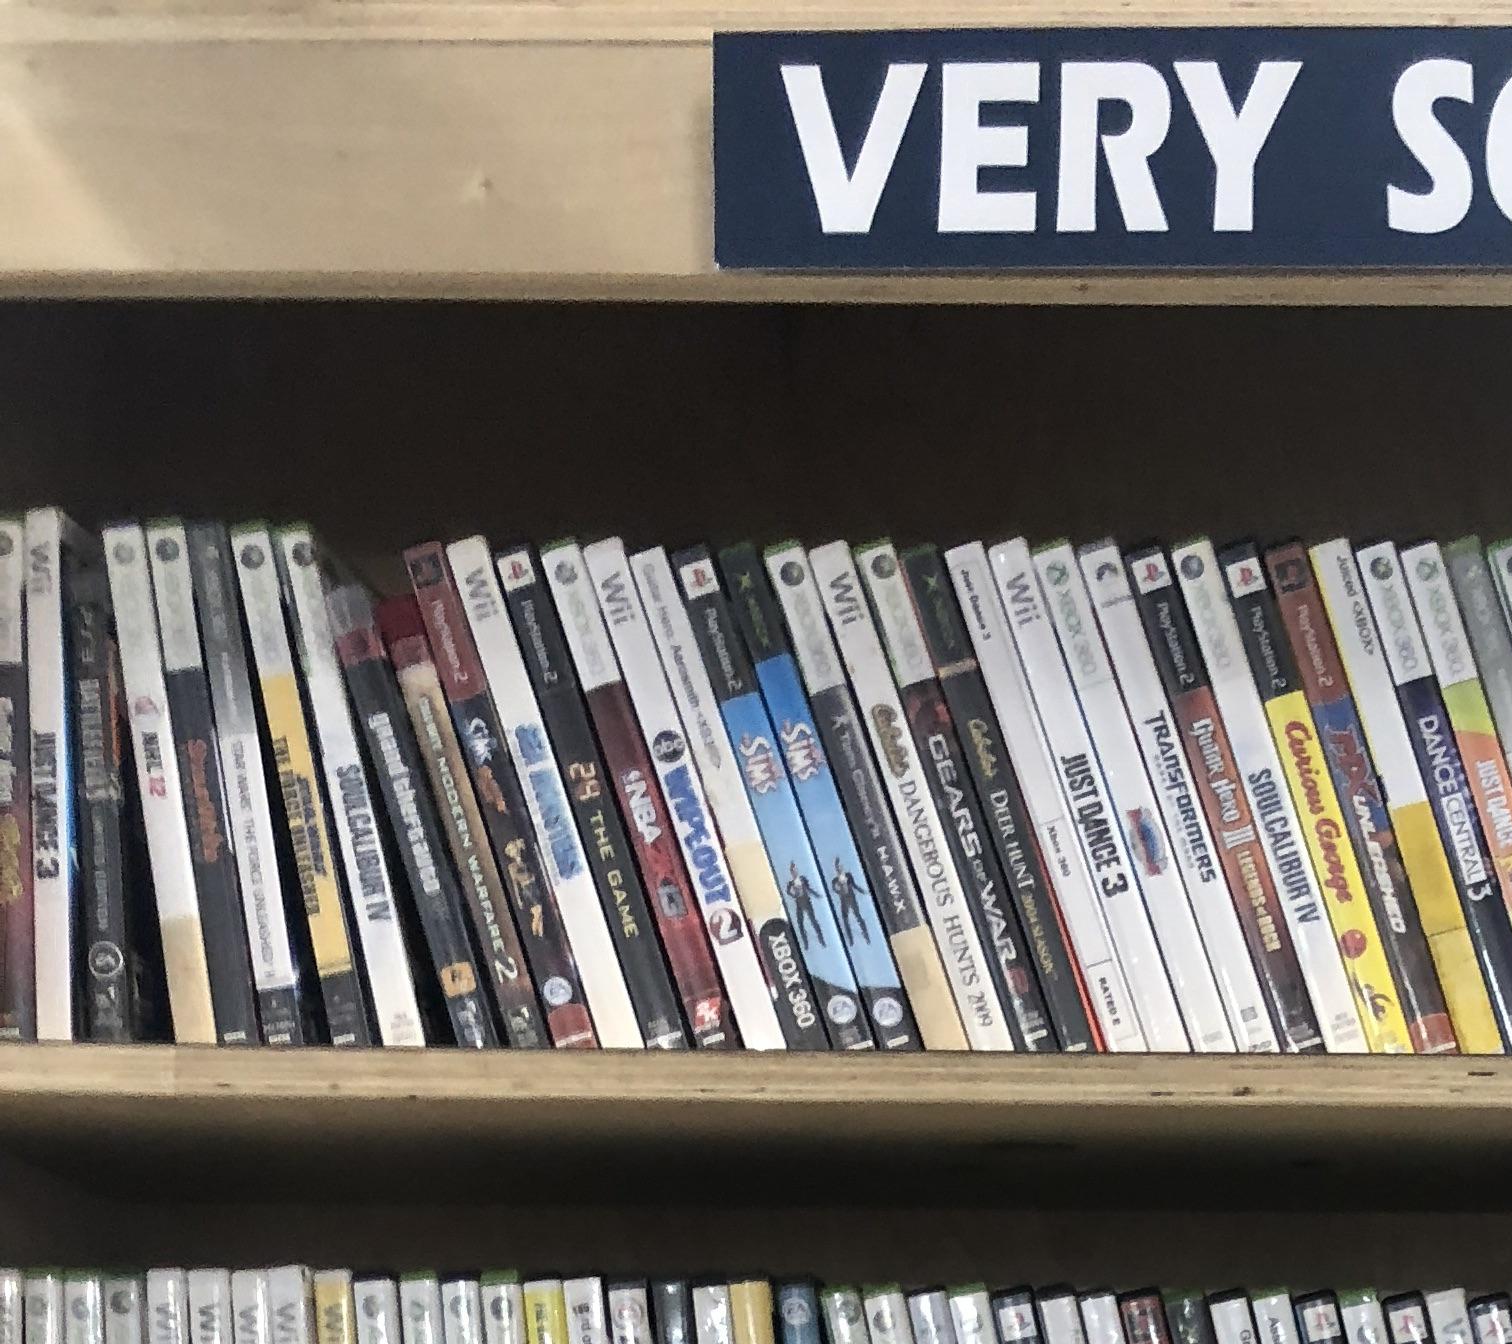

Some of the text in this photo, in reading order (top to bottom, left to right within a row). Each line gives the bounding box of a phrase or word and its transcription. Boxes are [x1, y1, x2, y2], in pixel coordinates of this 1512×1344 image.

[779, 60, 1303, 236] VERY
[828, 571, 866, 625] Wii
[568, 762, 639, 938] 24 THE GAME
[1060, 752, 1129, 897] JUST DANCE 3
[1144, 709, 1216, 883] TRANSFORMERS
[1246, 769, 1319, 925] SOULCALIBUR IV
[1283, 720, 1353, 904] Curious George
[767, 933, 815, 1028] XBOX 360
